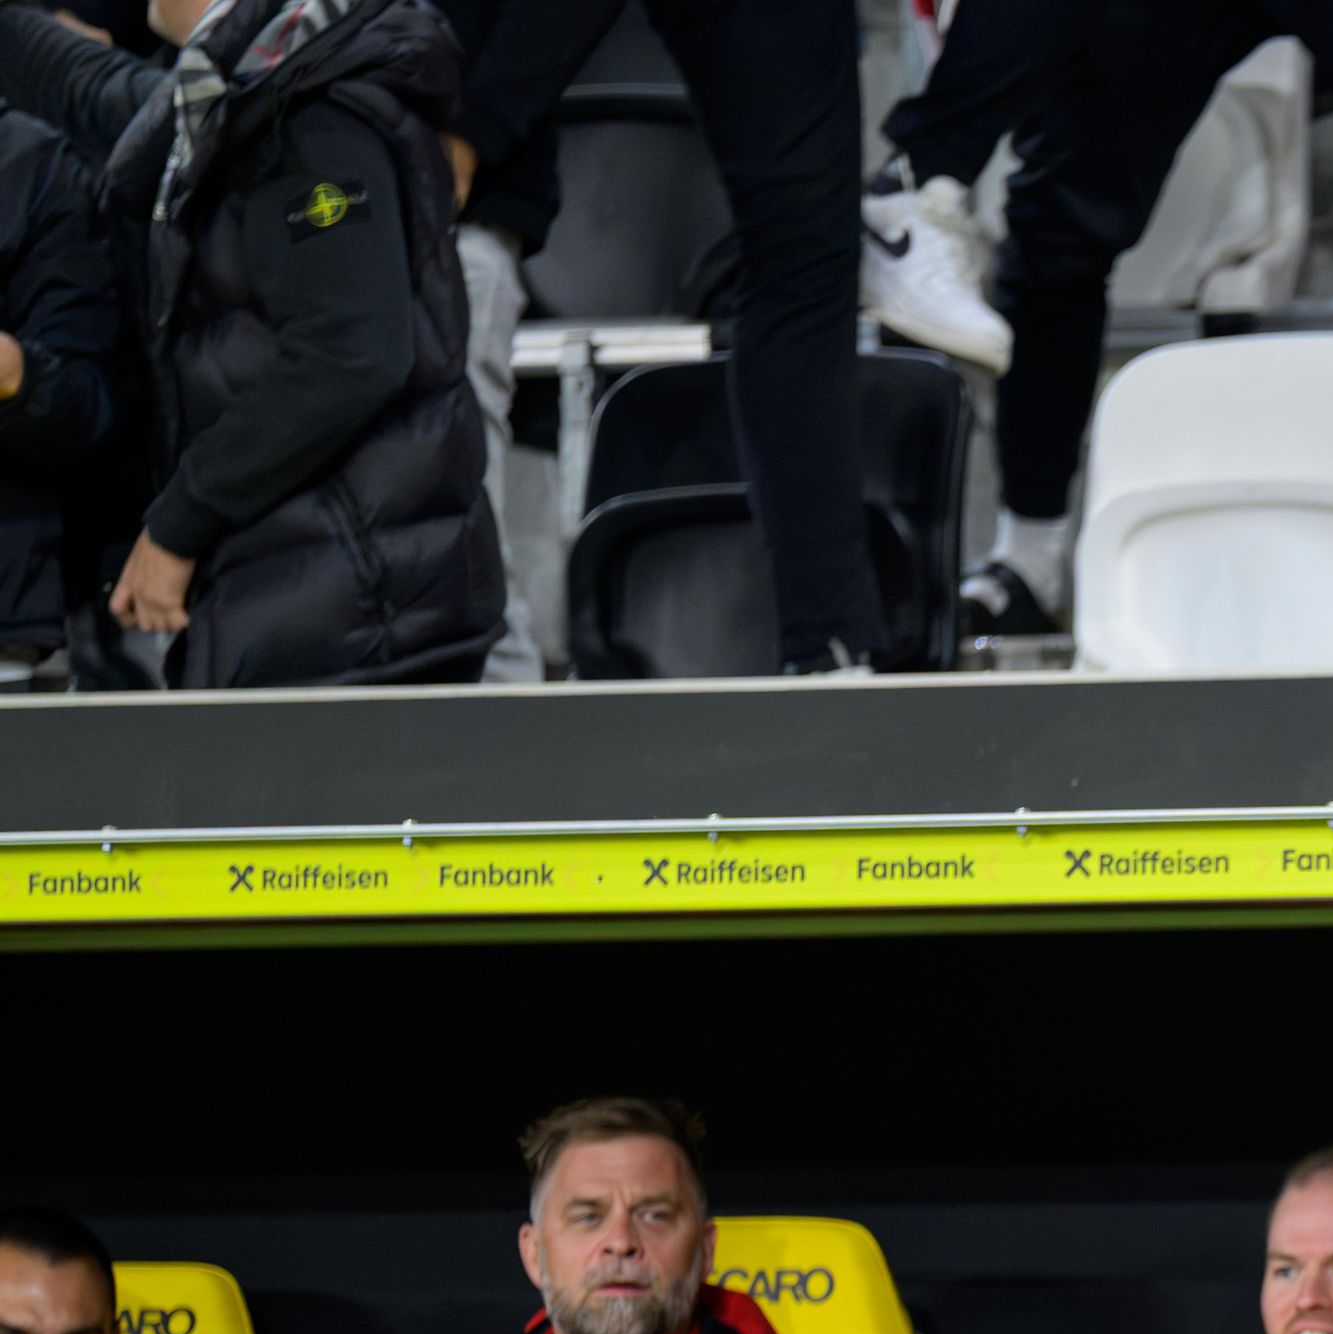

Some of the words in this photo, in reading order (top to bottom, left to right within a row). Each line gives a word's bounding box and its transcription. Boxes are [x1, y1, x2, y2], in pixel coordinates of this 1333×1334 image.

[677, 858, 806, 885] Raiffeisen
[857, 855, 974, 880] Fanbank
[1098, 849, 1230, 875] Raiffeisen
[28, 870, 141, 895] Fanbank
[262, 865, 388, 890] Raiffeisen
[439, 863, 554, 887] Fanbank
[716, 1267, 834, 1303] CARO
